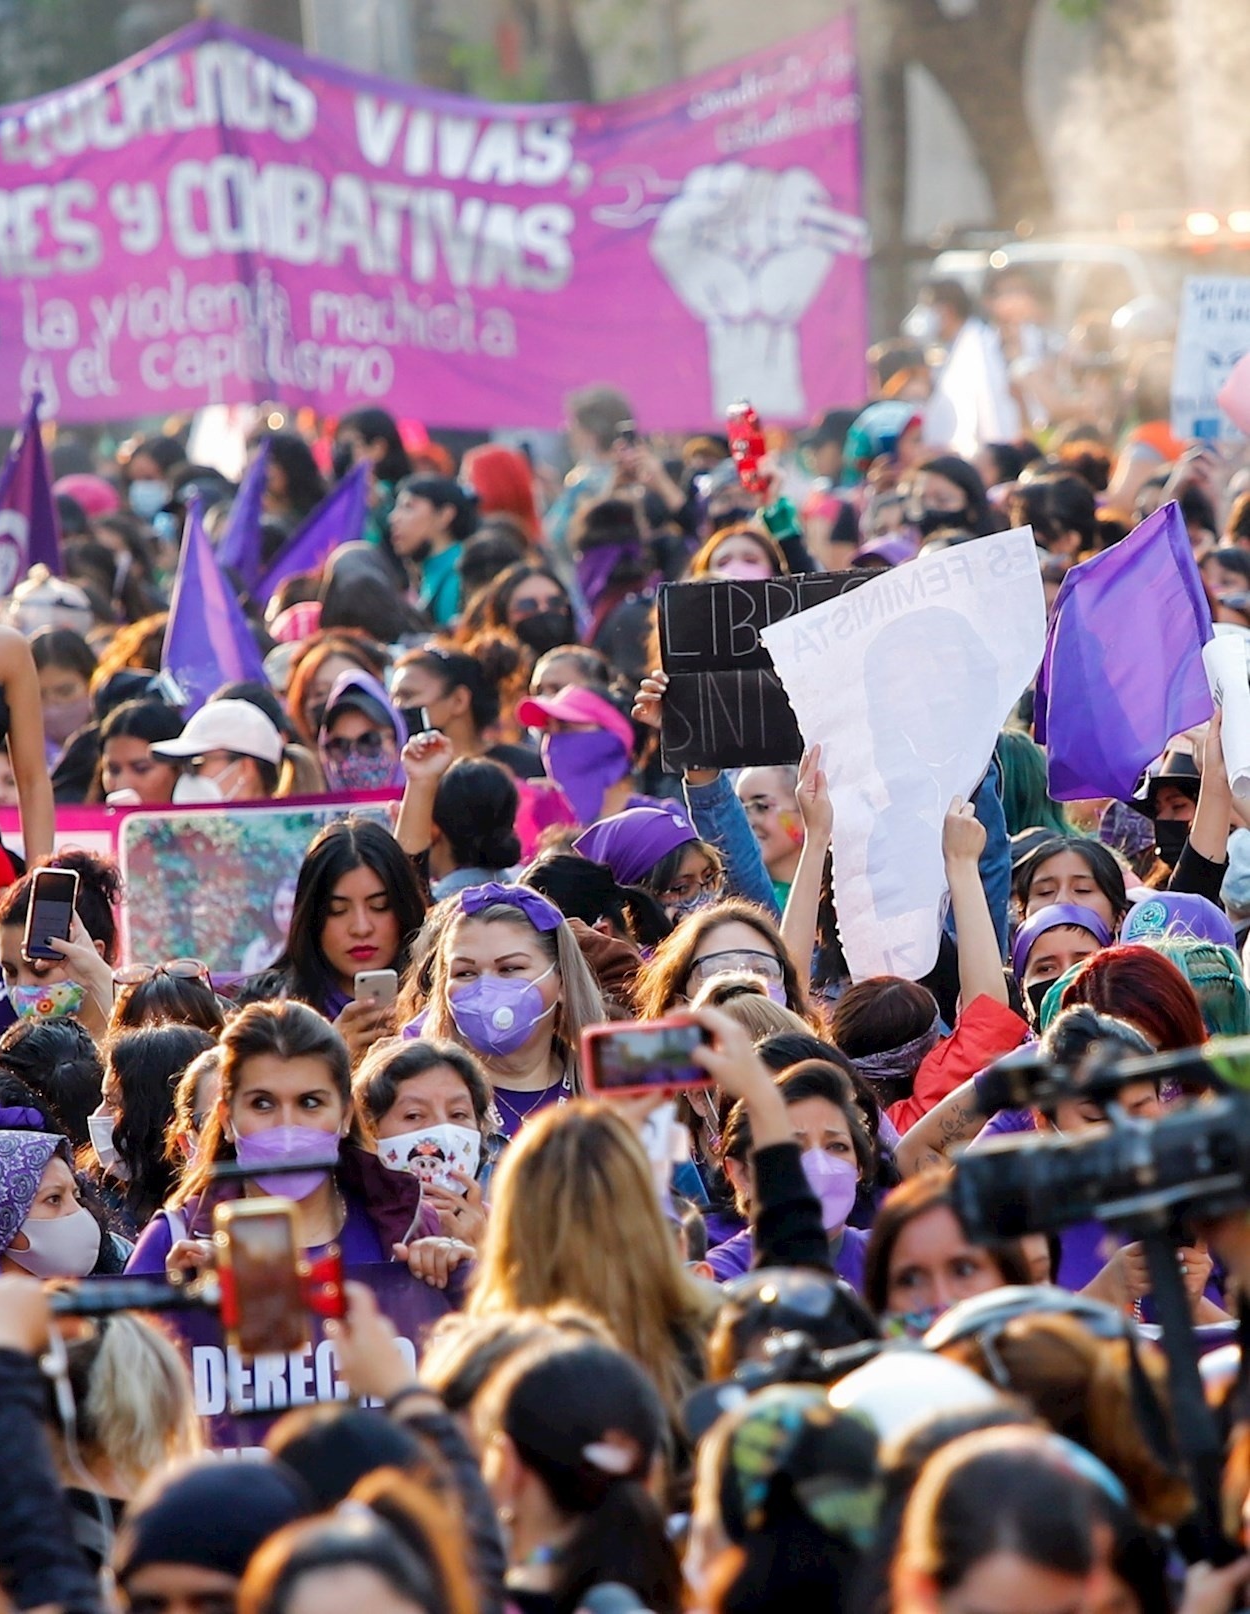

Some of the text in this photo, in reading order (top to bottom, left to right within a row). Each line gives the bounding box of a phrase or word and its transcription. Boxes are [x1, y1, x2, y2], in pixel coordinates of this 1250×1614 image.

[354, 92, 595, 198] VIVAS,
[167, 153, 576, 293] COMBATIVAS
[19, 280, 79, 352] la
[90, 266, 291, 344] violenia
[66, 330, 121, 399] el
[192, 1336, 417, 1417] DEREC
